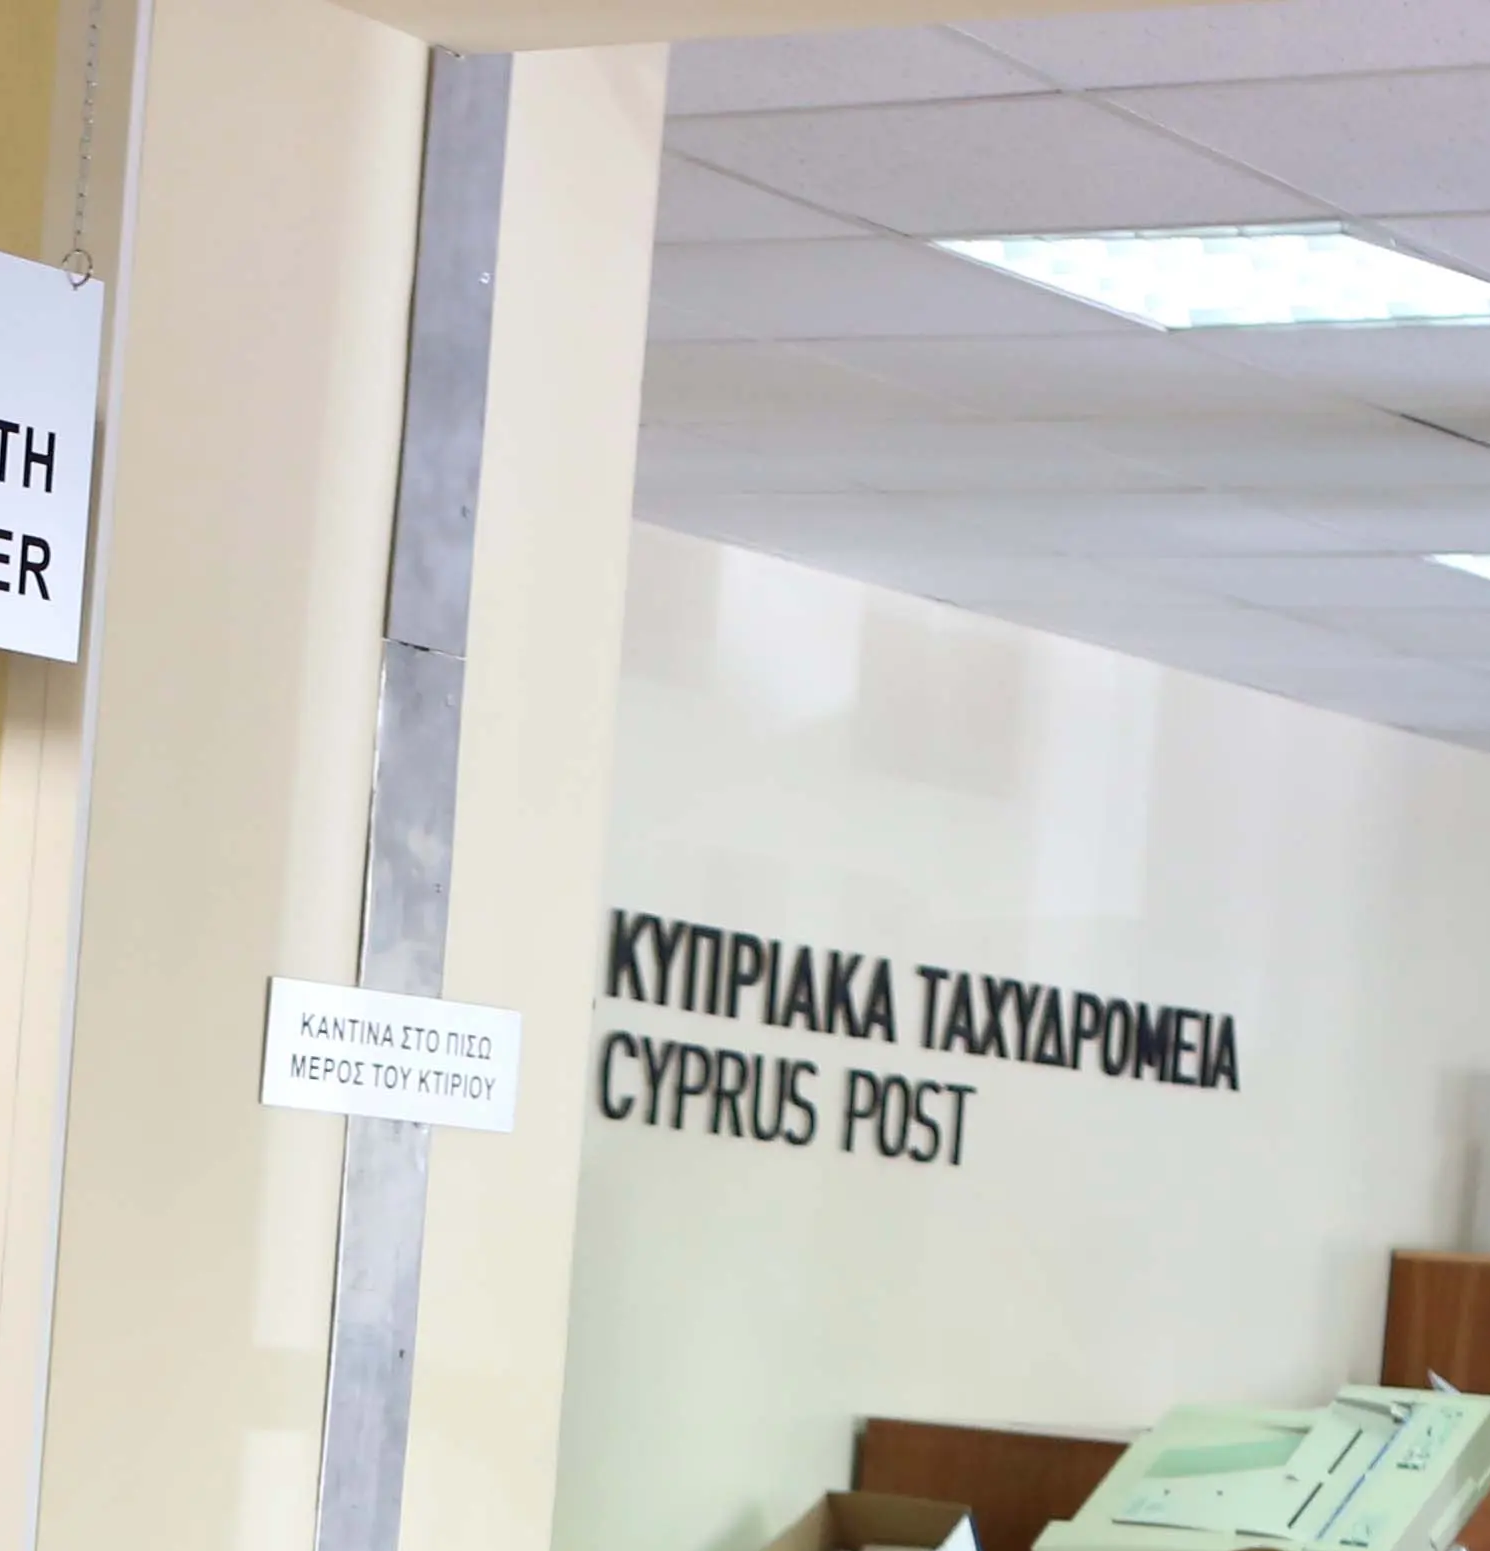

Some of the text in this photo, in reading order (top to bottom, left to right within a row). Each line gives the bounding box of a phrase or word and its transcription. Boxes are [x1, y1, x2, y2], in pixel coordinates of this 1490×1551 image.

[299, 1011, 493, 1061] ΚΑΝΤΙΝΑ ΣΤΟ ΠΙΣΩ
[603, 906, 1241, 1092] ΚΥΠΡΙΑΚΑ ΤΑΧΥΔΡΟΜΕΙΑ
[290, 1053, 497, 1102] ΜΕΡΟΣ ΤΟΥ ΚΤΙΡΙΟΥ
[596, 1028, 978, 1166] CYPRUS POST
